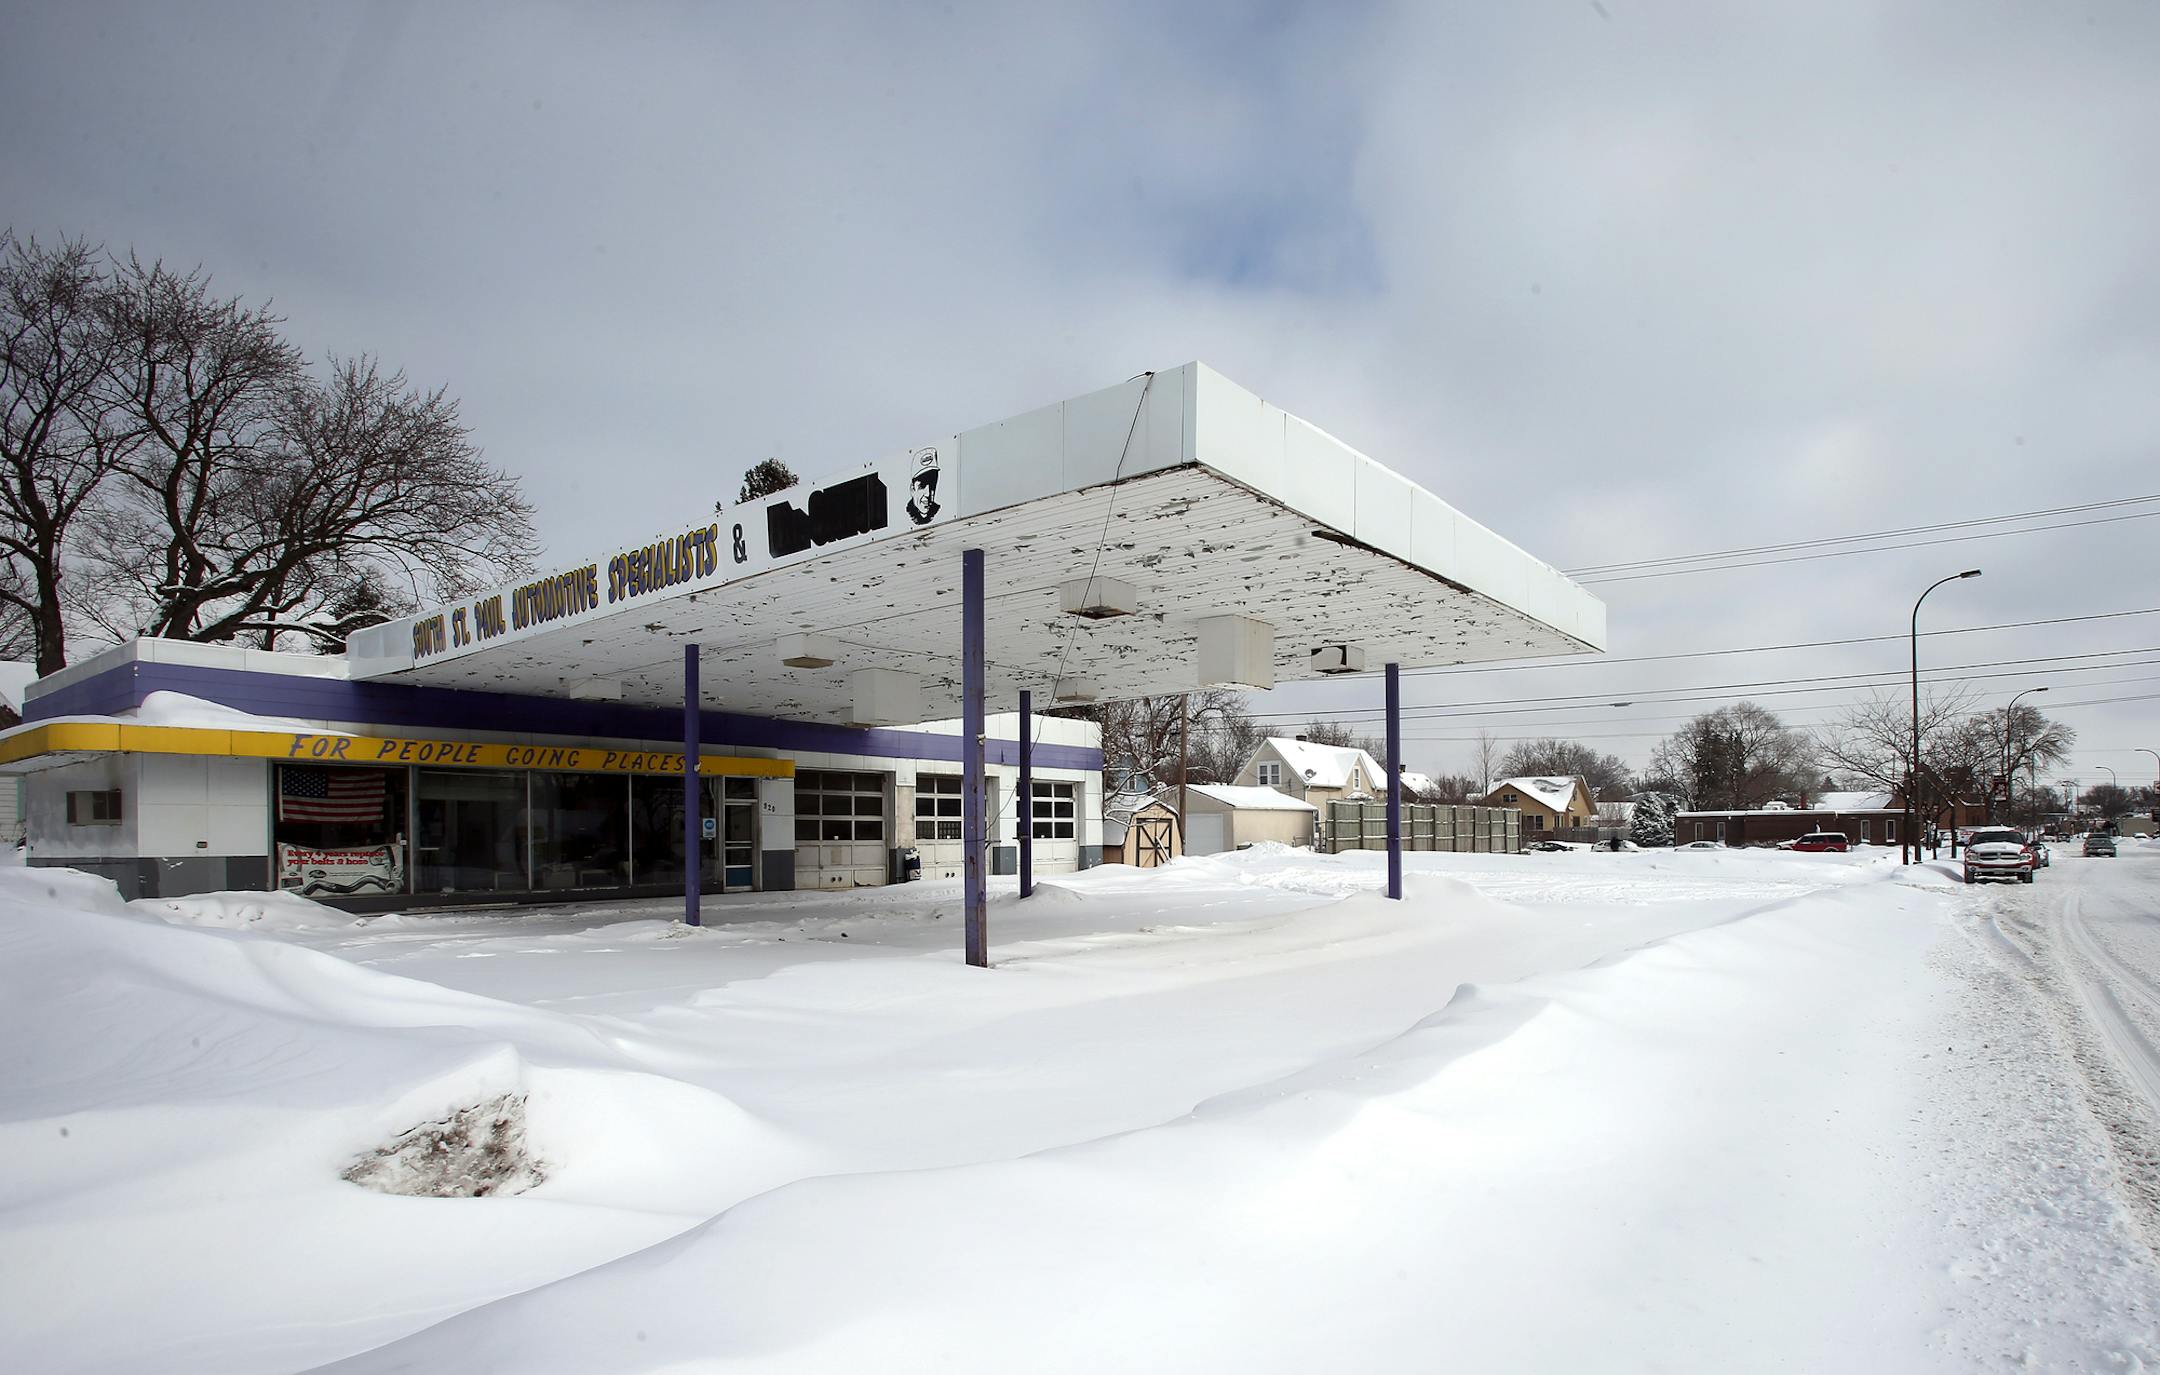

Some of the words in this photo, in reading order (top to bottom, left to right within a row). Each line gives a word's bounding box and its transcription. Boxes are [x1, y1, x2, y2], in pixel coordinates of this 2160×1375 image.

[413, 613, 447, 660] SOUTH
[452, 606, 471, 648] ST.
[474, 594, 506, 642] PAUL
[512, 563, 599, 631] AUTOMOTIVE
[608, 523, 718, 604] SPECIALISTS
[733, 523, 748, 564] &
[289, 734, 351, 760] FOR
[376, 740, 483, 763] PEOPLE
[506, 747, 580, 767] GOING
[287, 858, 309, 867] your
